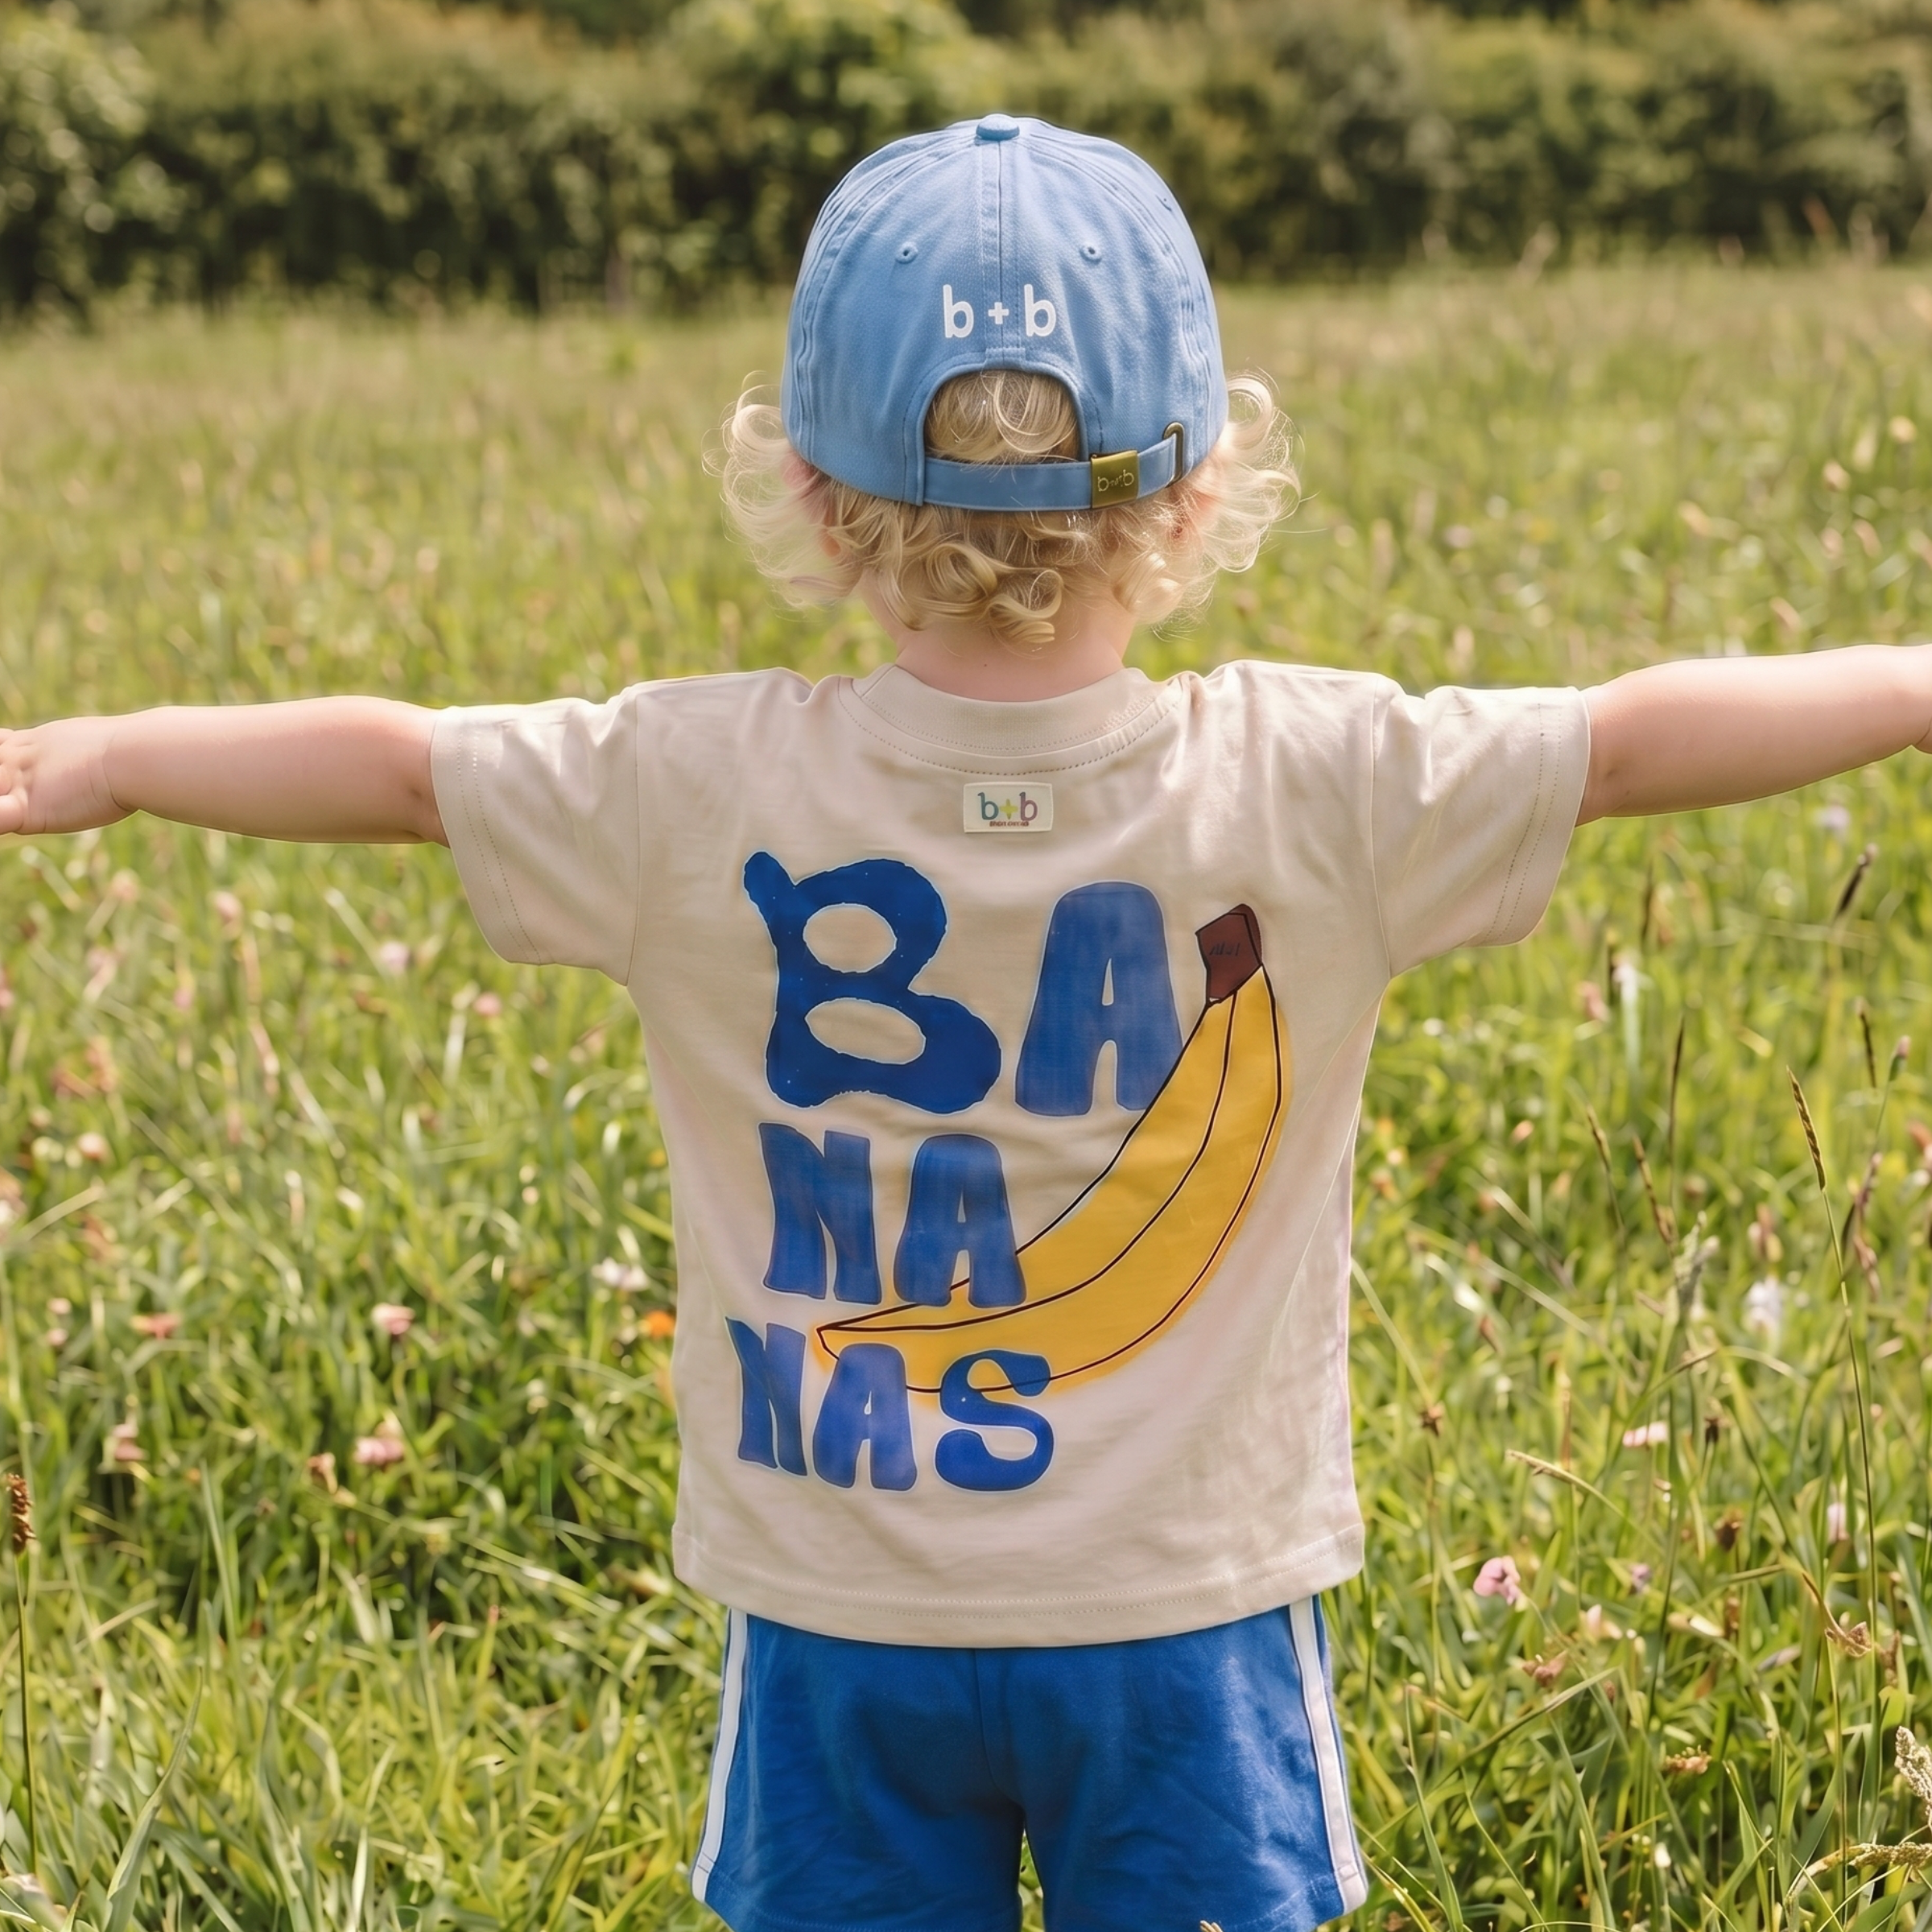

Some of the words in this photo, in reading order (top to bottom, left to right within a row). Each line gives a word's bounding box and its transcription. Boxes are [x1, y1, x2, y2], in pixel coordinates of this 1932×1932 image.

[977, 791, 1038, 821] b+b
[744, 851, 1184, 1117] BA
[758, 1122, 1026, 1307] NA
[725, 1316, 1055, 1491] NAS
